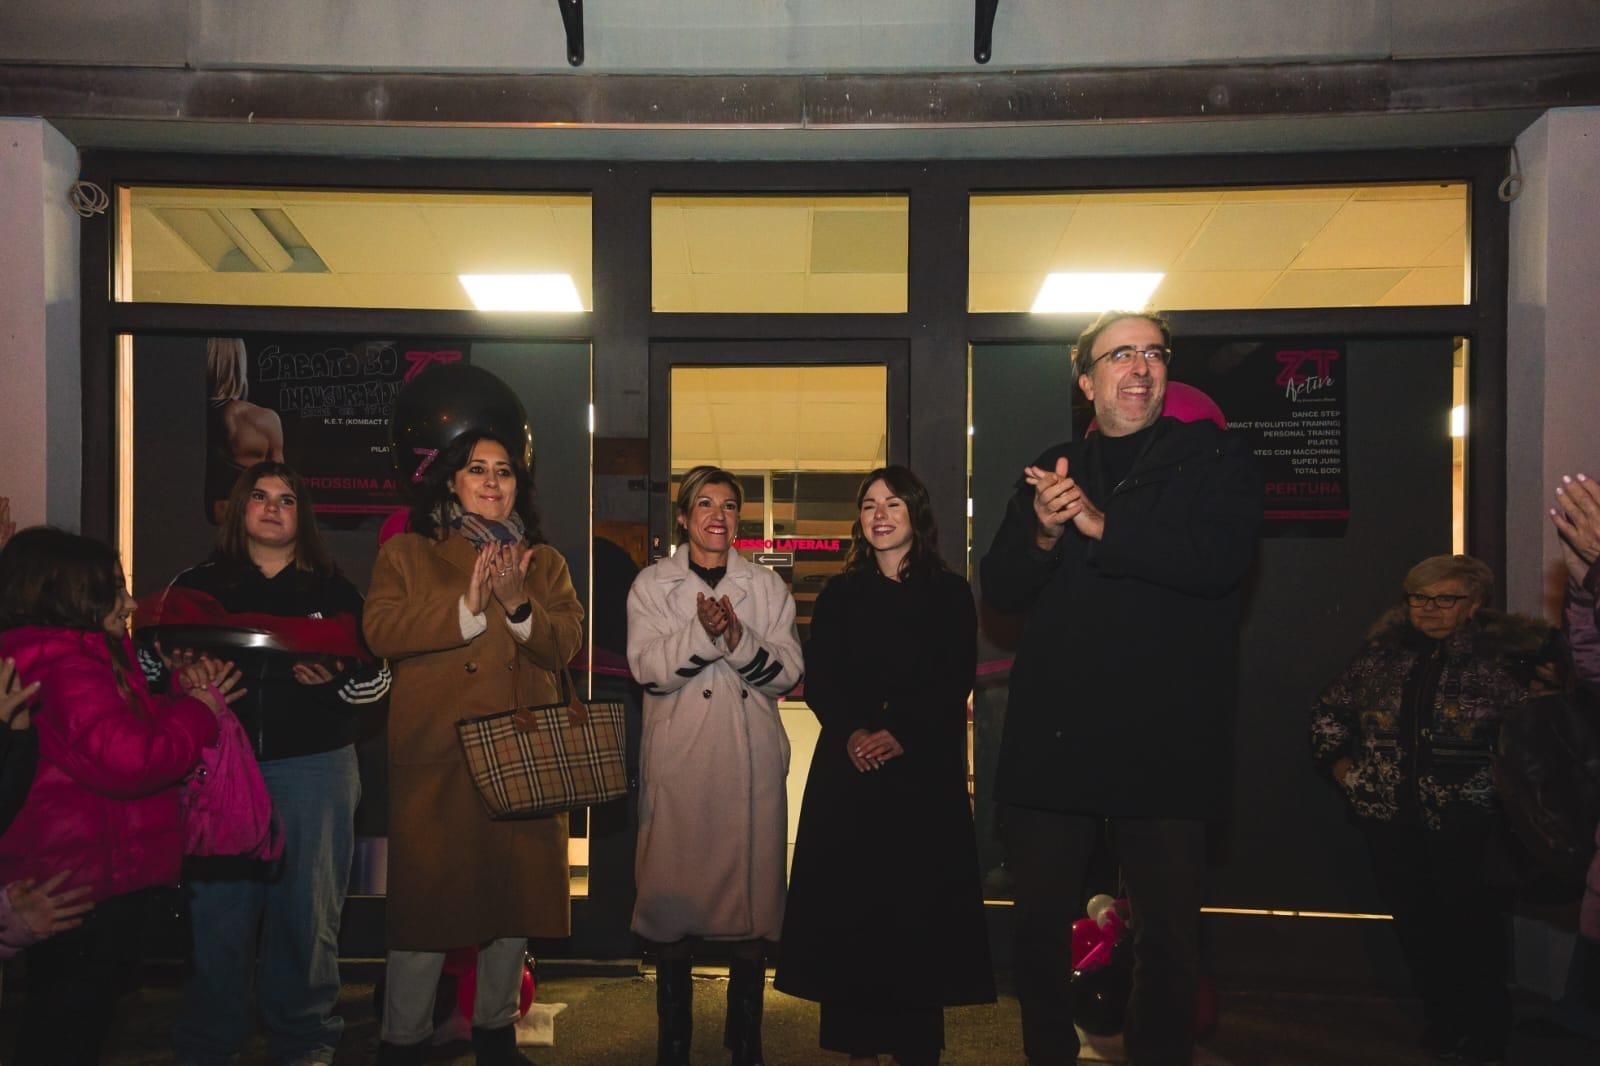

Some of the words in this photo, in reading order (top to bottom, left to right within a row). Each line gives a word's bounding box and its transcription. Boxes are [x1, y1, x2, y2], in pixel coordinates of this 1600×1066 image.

[257, 344, 359, 382] SABATO
[1275, 349, 1341, 385] ZT
[1285, 375, 1335, 403] Active
[345, 418, 382, 426] (KOMBACT
[1254, 421, 1299, 429] EVOLUTION
[303, 478, 378, 488] PROSSIMA
[776, 539, 841, 550] LATERALE
